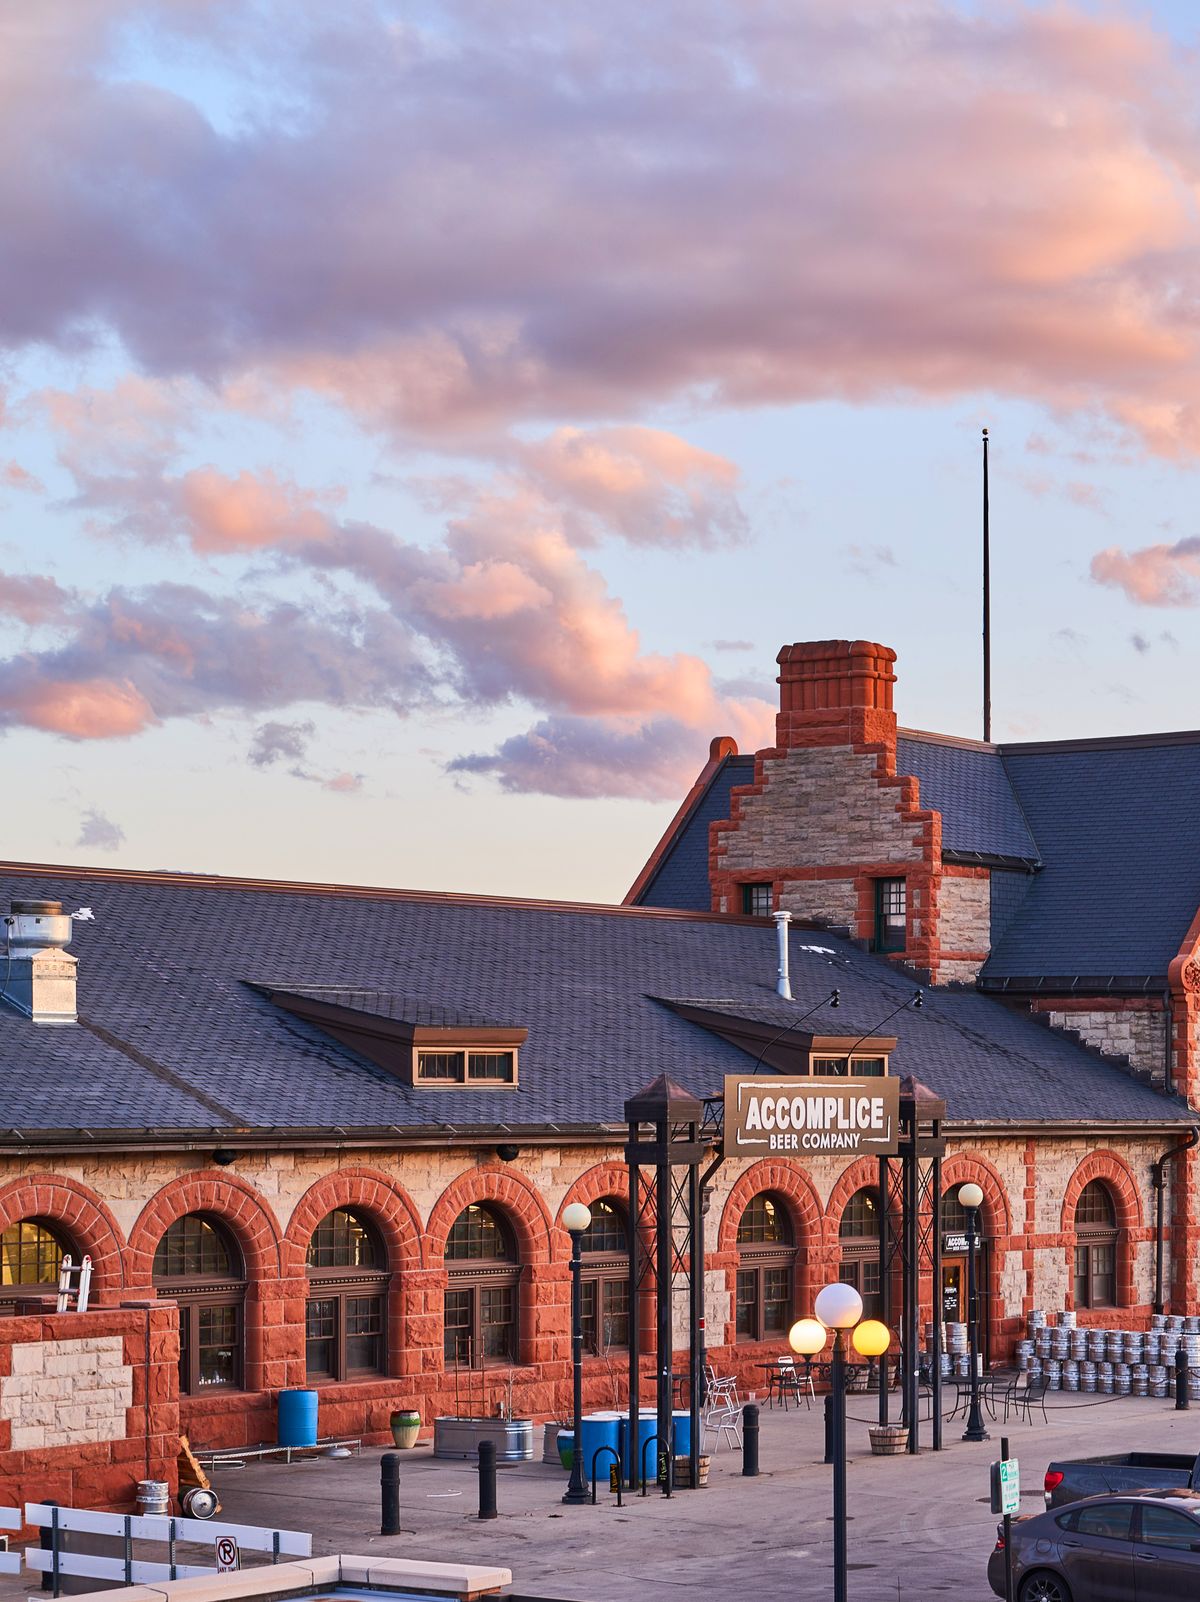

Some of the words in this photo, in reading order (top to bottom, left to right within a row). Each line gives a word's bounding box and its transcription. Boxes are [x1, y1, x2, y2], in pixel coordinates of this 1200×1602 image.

[745, 1096, 884, 1130] ACCOMPLICE
[769, 1134, 799, 1150] BEER
[801, 1132, 861, 1149] COMPANY
